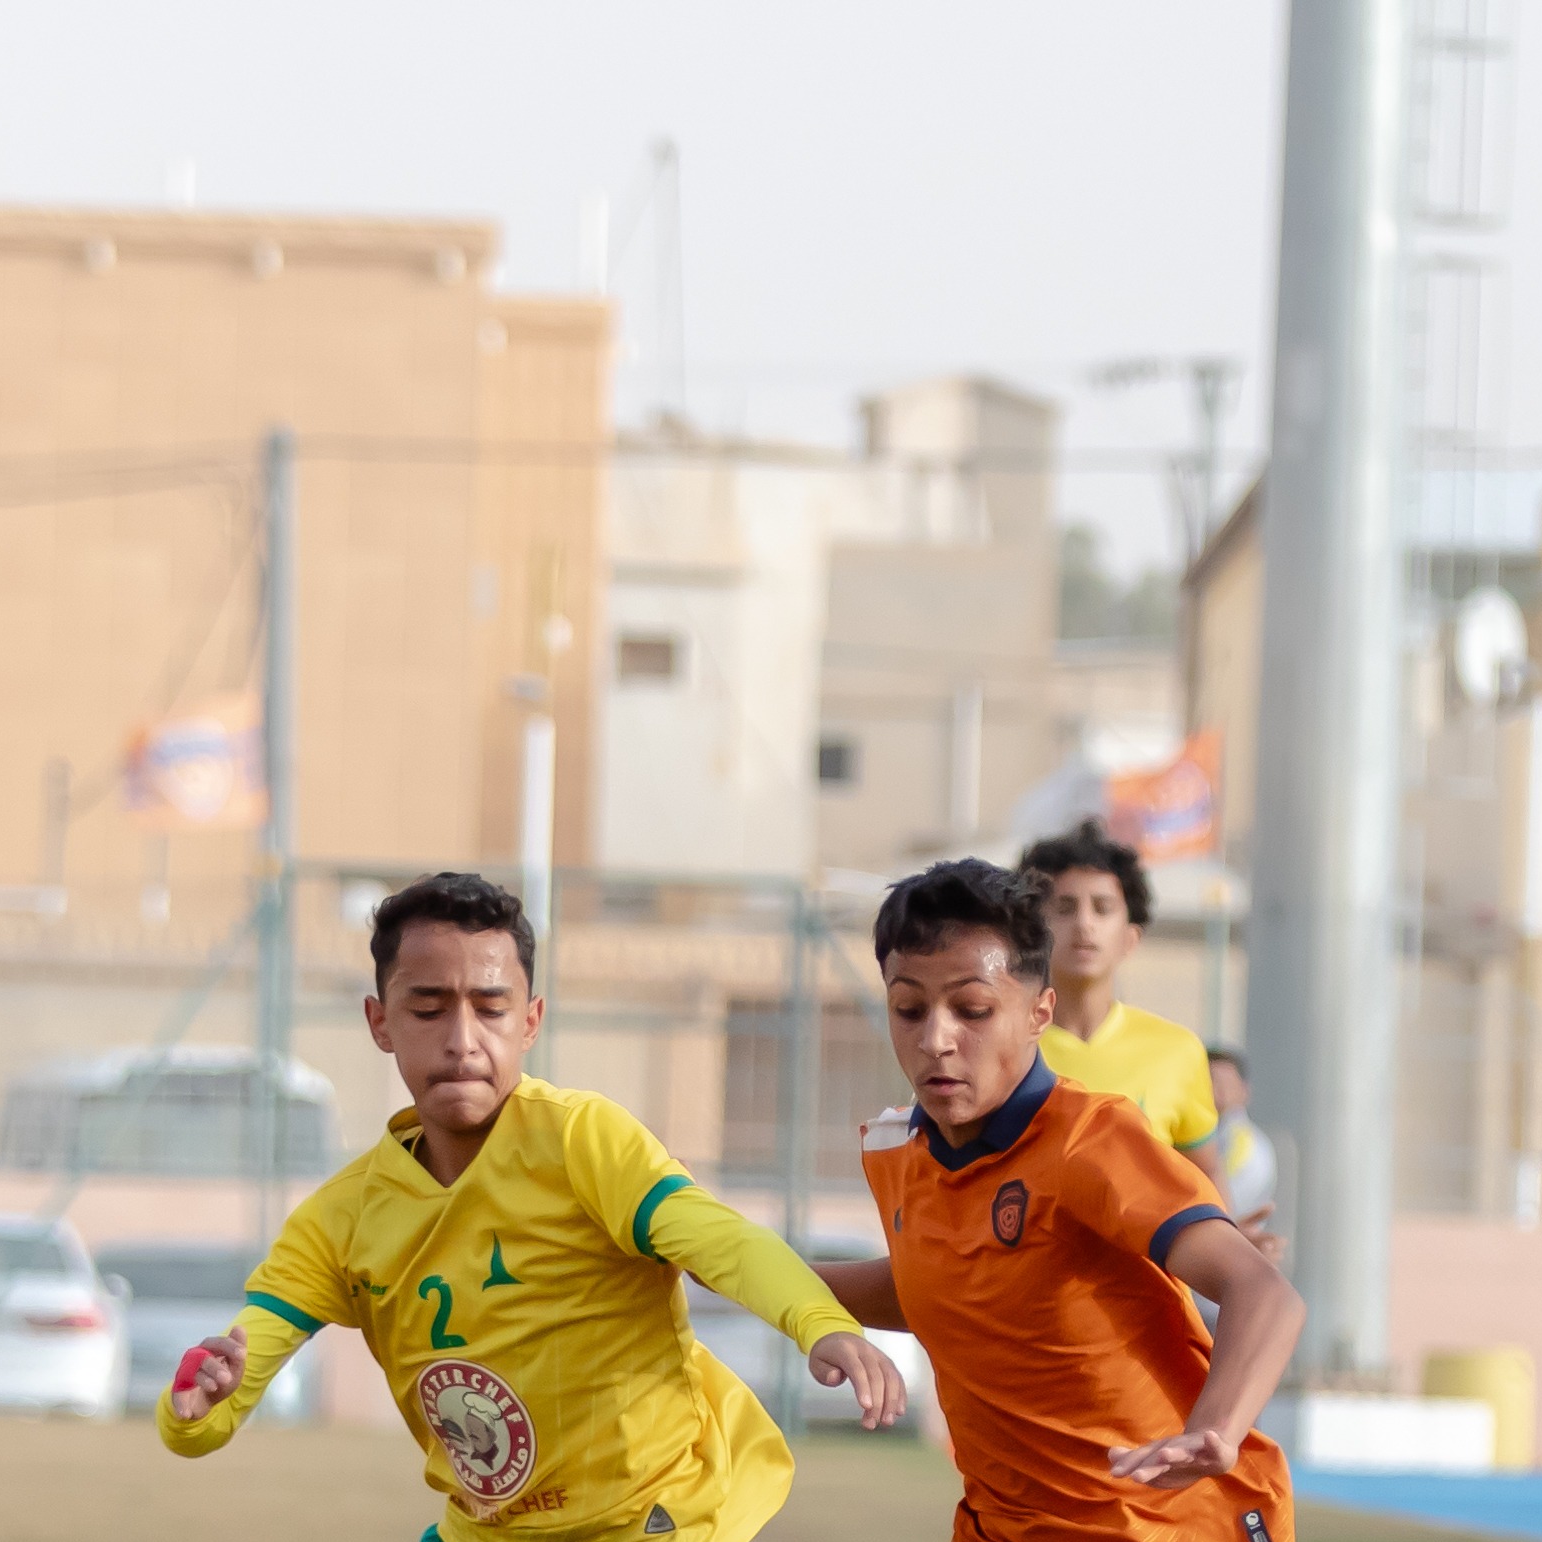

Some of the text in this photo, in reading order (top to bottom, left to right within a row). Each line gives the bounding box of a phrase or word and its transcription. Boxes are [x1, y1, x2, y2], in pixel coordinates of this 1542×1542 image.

[418, 1274, 467, 1350] 2
[425, 1368, 524, 1427] MASTER CHEF
[506, 1488, 569, 1516] CHEF
